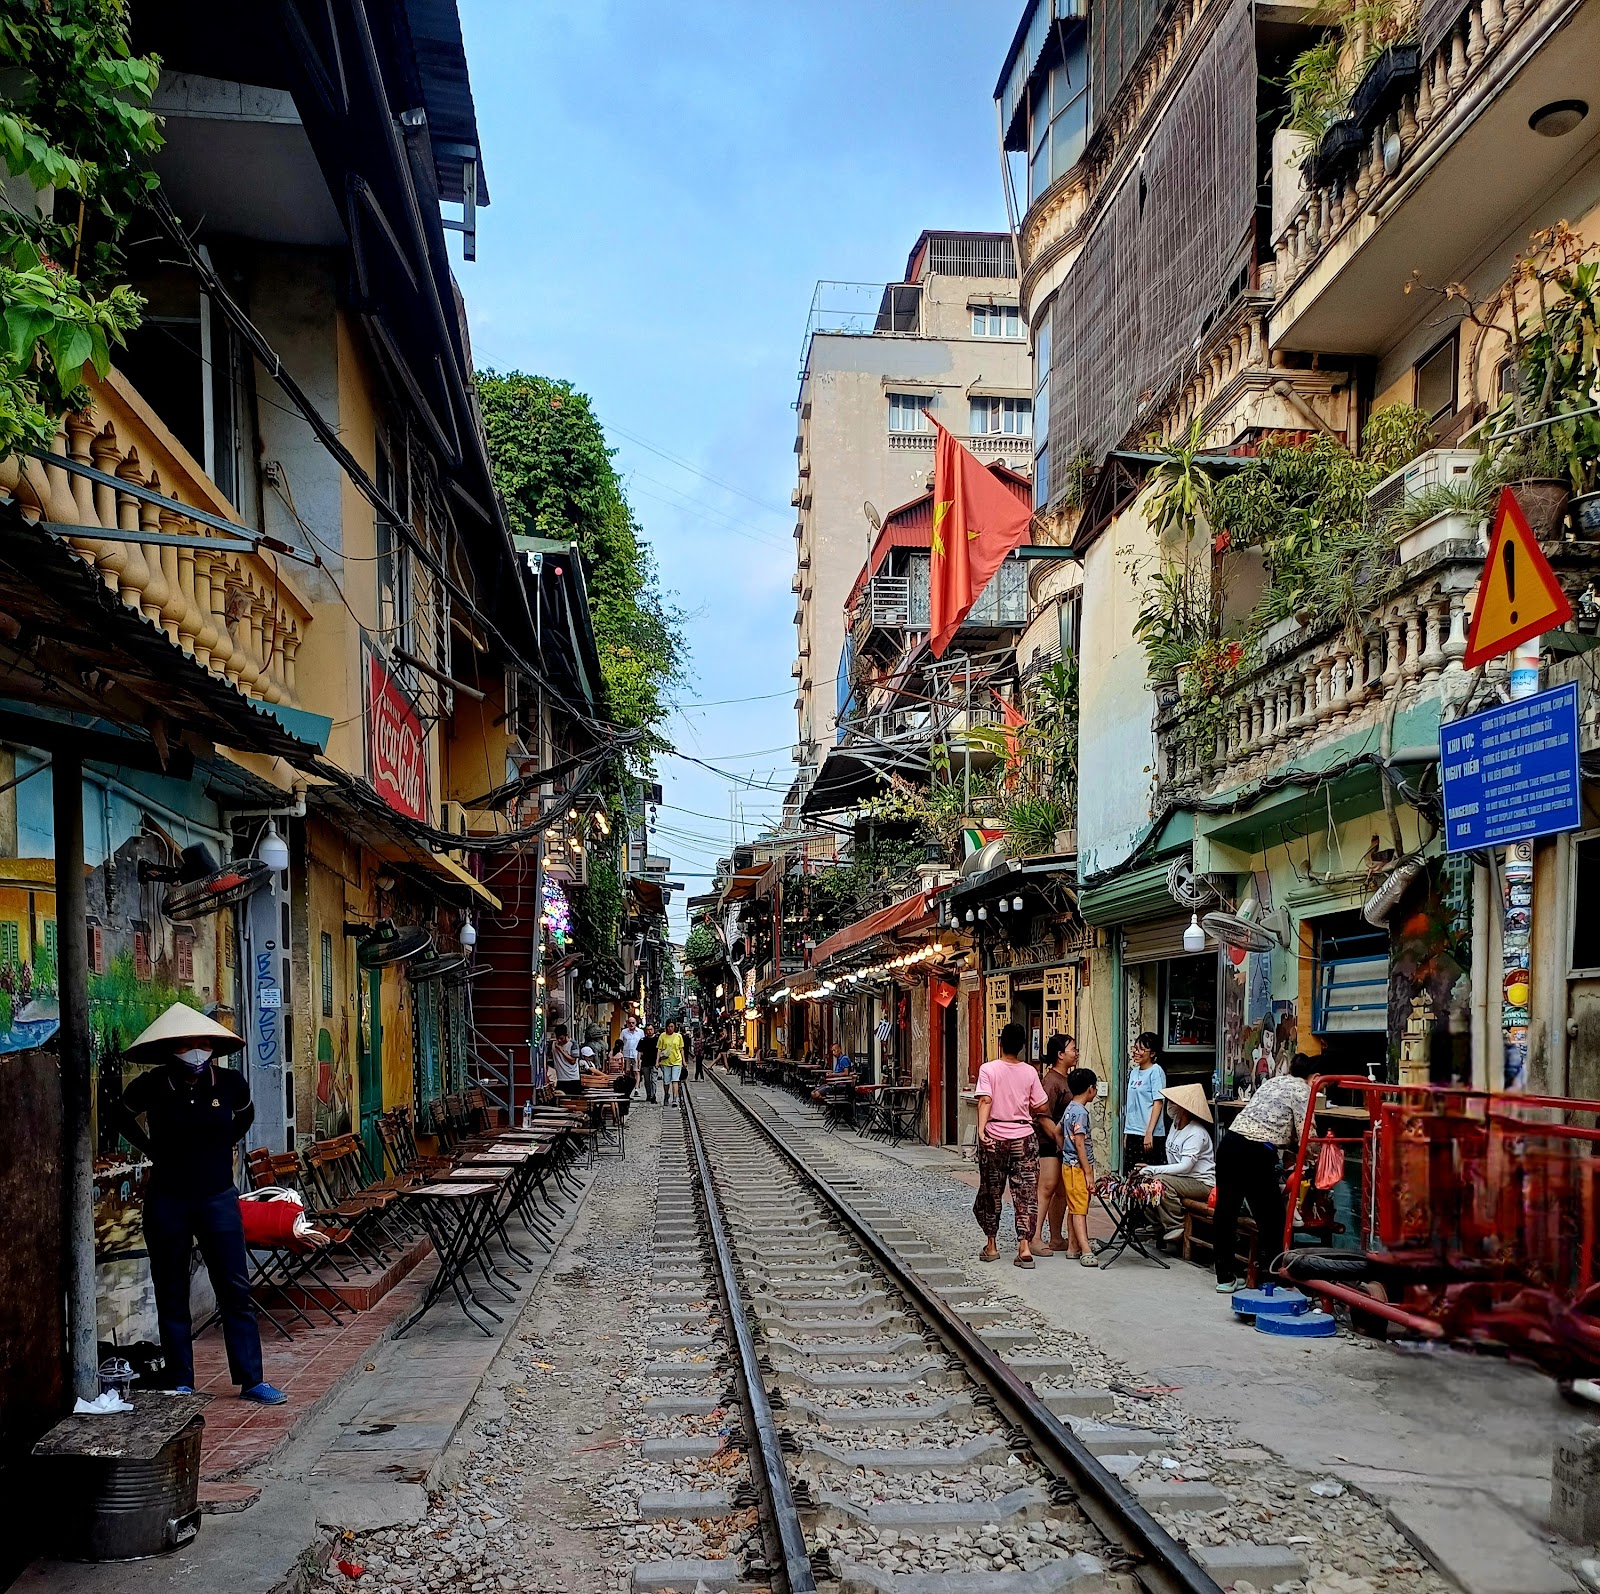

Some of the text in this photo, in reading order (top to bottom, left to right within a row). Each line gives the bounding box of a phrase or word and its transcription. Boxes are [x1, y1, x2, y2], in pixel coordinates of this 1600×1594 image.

[1447, 731, 1475, 755] KHU VỰC
[1445, 753, 1480, 781] NGUY HIỂM
[1448, 802, 1479, 819] DANGEROUS
[1457, 822, 1471, 836] AREA
